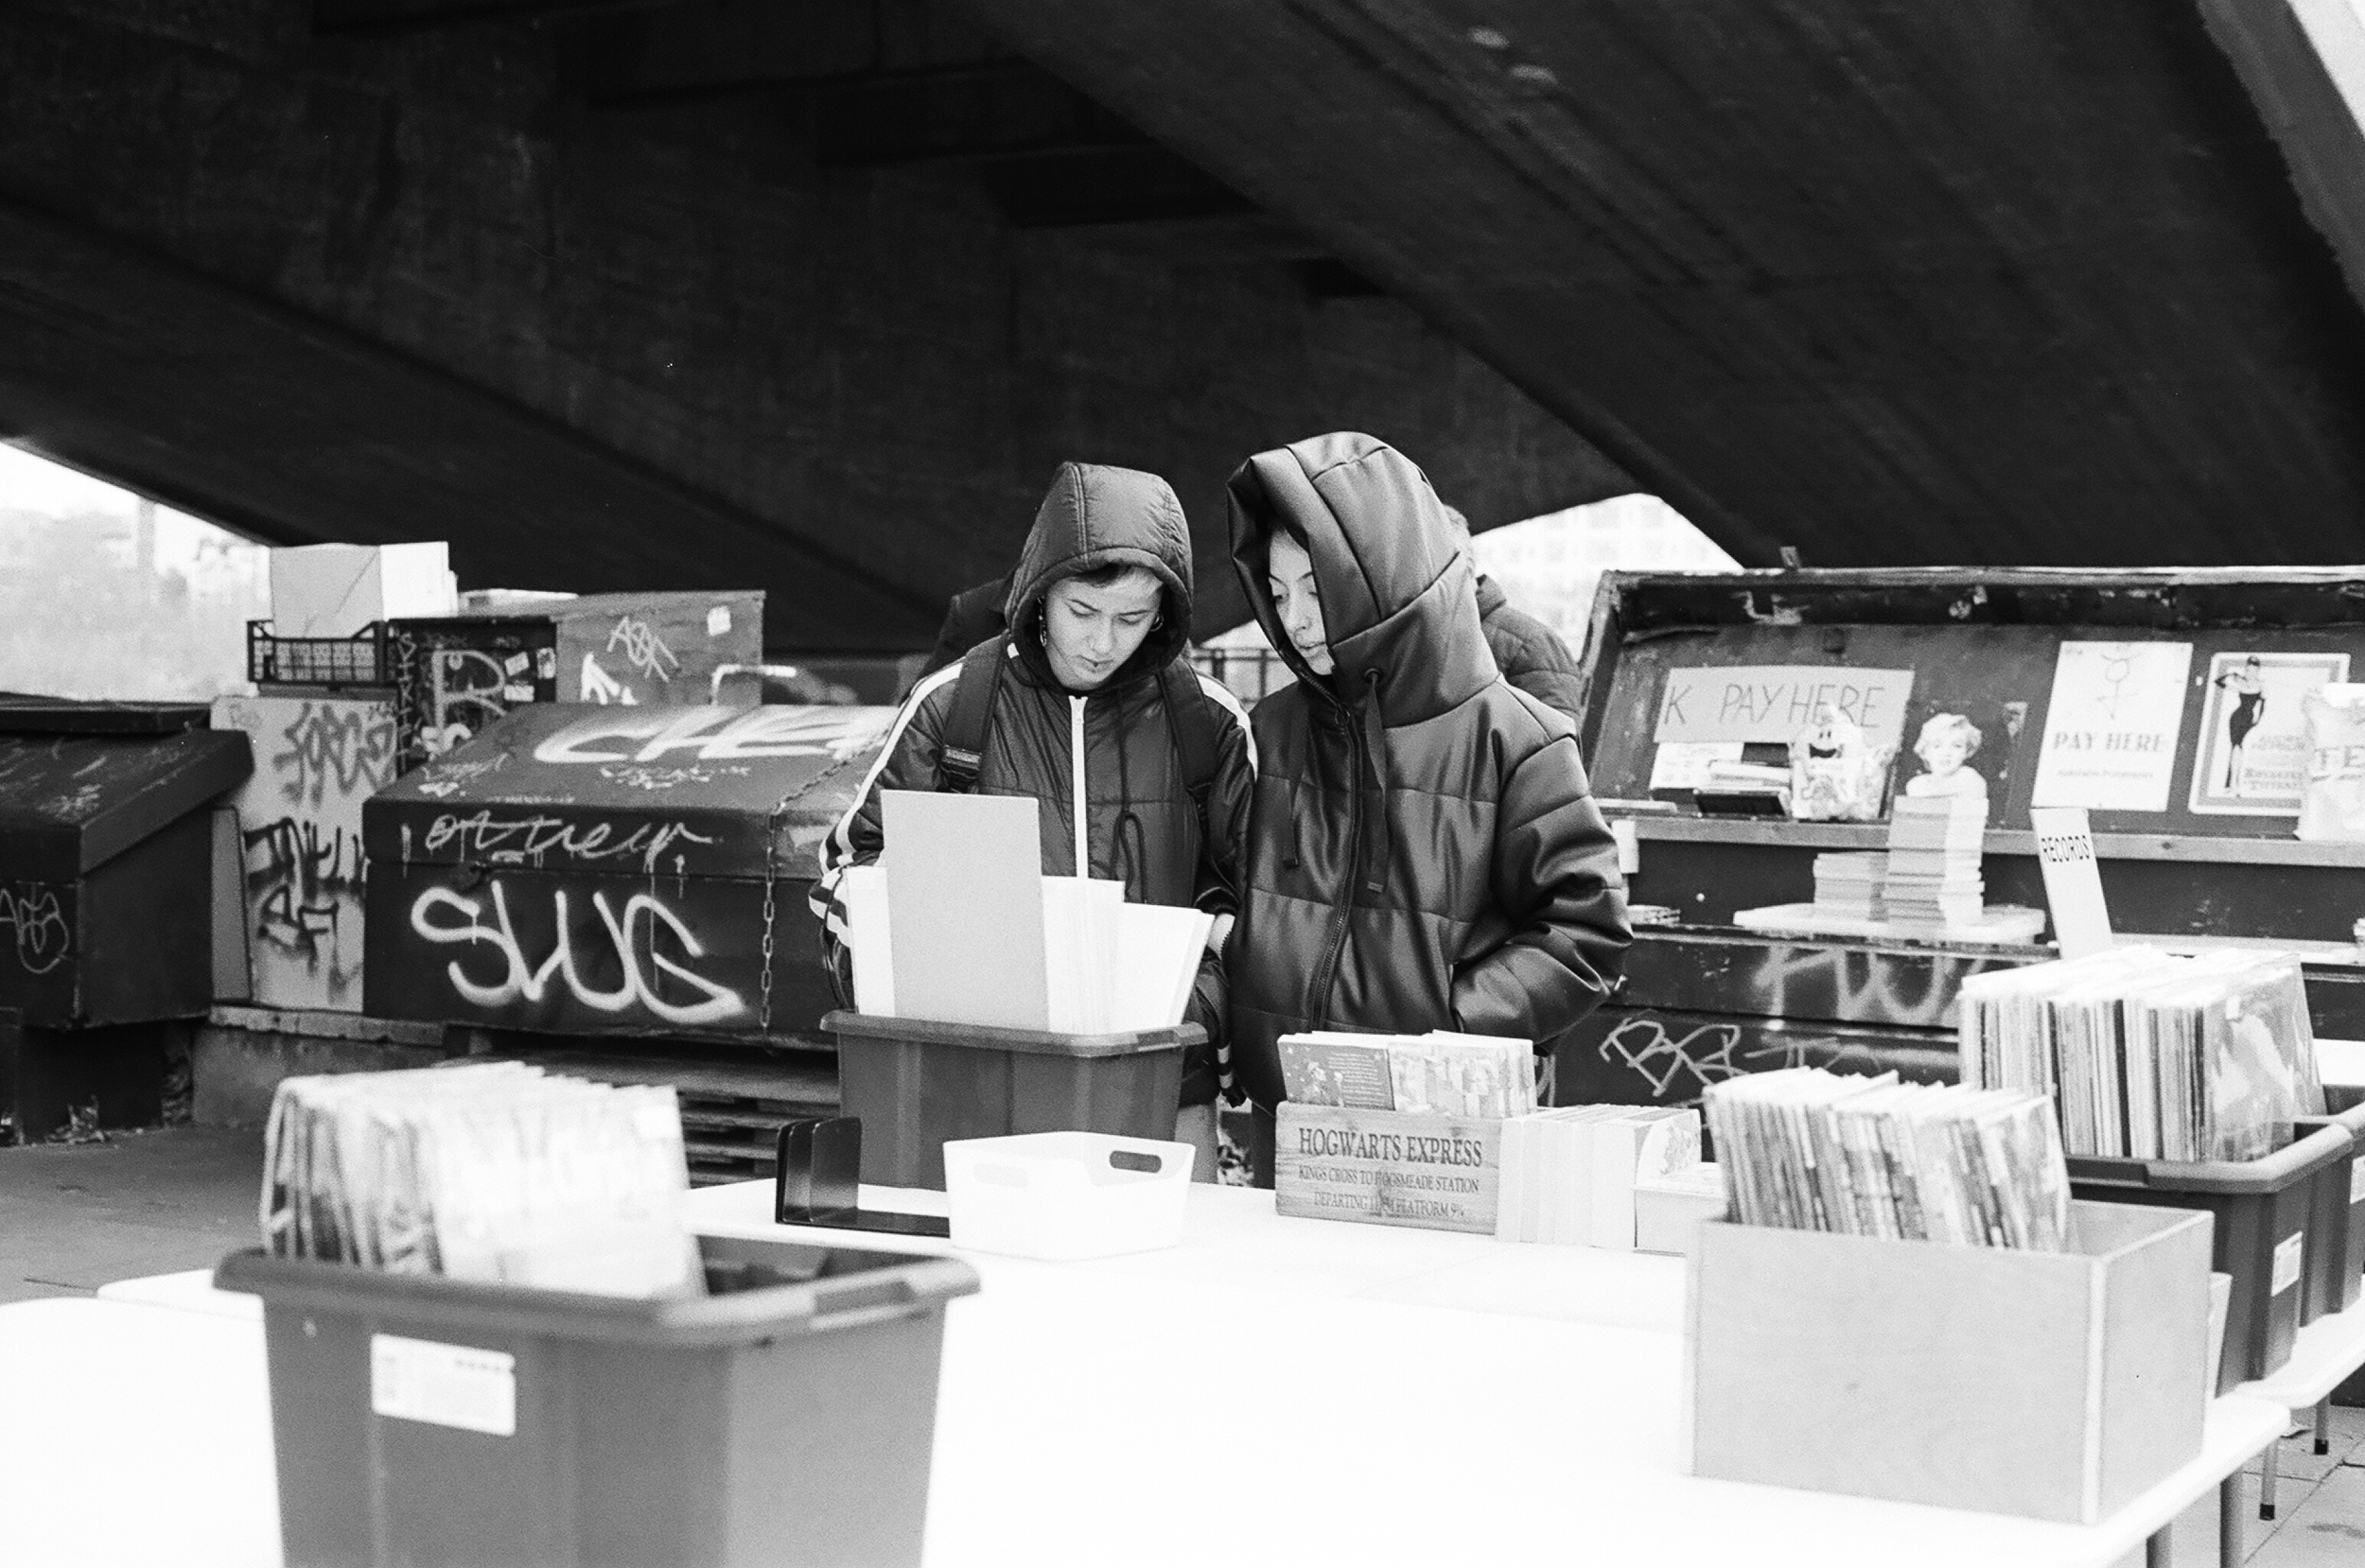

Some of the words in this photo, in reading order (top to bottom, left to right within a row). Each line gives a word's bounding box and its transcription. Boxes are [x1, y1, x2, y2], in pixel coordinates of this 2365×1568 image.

[1718, 683, 1786, 724] PAY
[1787, 683, 1886, 729] HERE
[2053, 732, 2098, 751] PAY
[2105, 732, 2164, 754] HERE
[2040, 834, 2091, 863] RECORDS
[411, 880, 745, 1024] SLUG
[1298, 1127, 1402, 1162] HOGWARTS
[1406, 1135, 1483, 1168] EXPRESS
[1298, 1164, 1327, 1182] KINGS
[1328, 1167, 1358, 1186] CROSS
[1359, 1169, 1374, 1187] TO
[1436, 1176, 1480, 1193] STATION
[1314, 1190, 1368, 1211] DEPARTING
